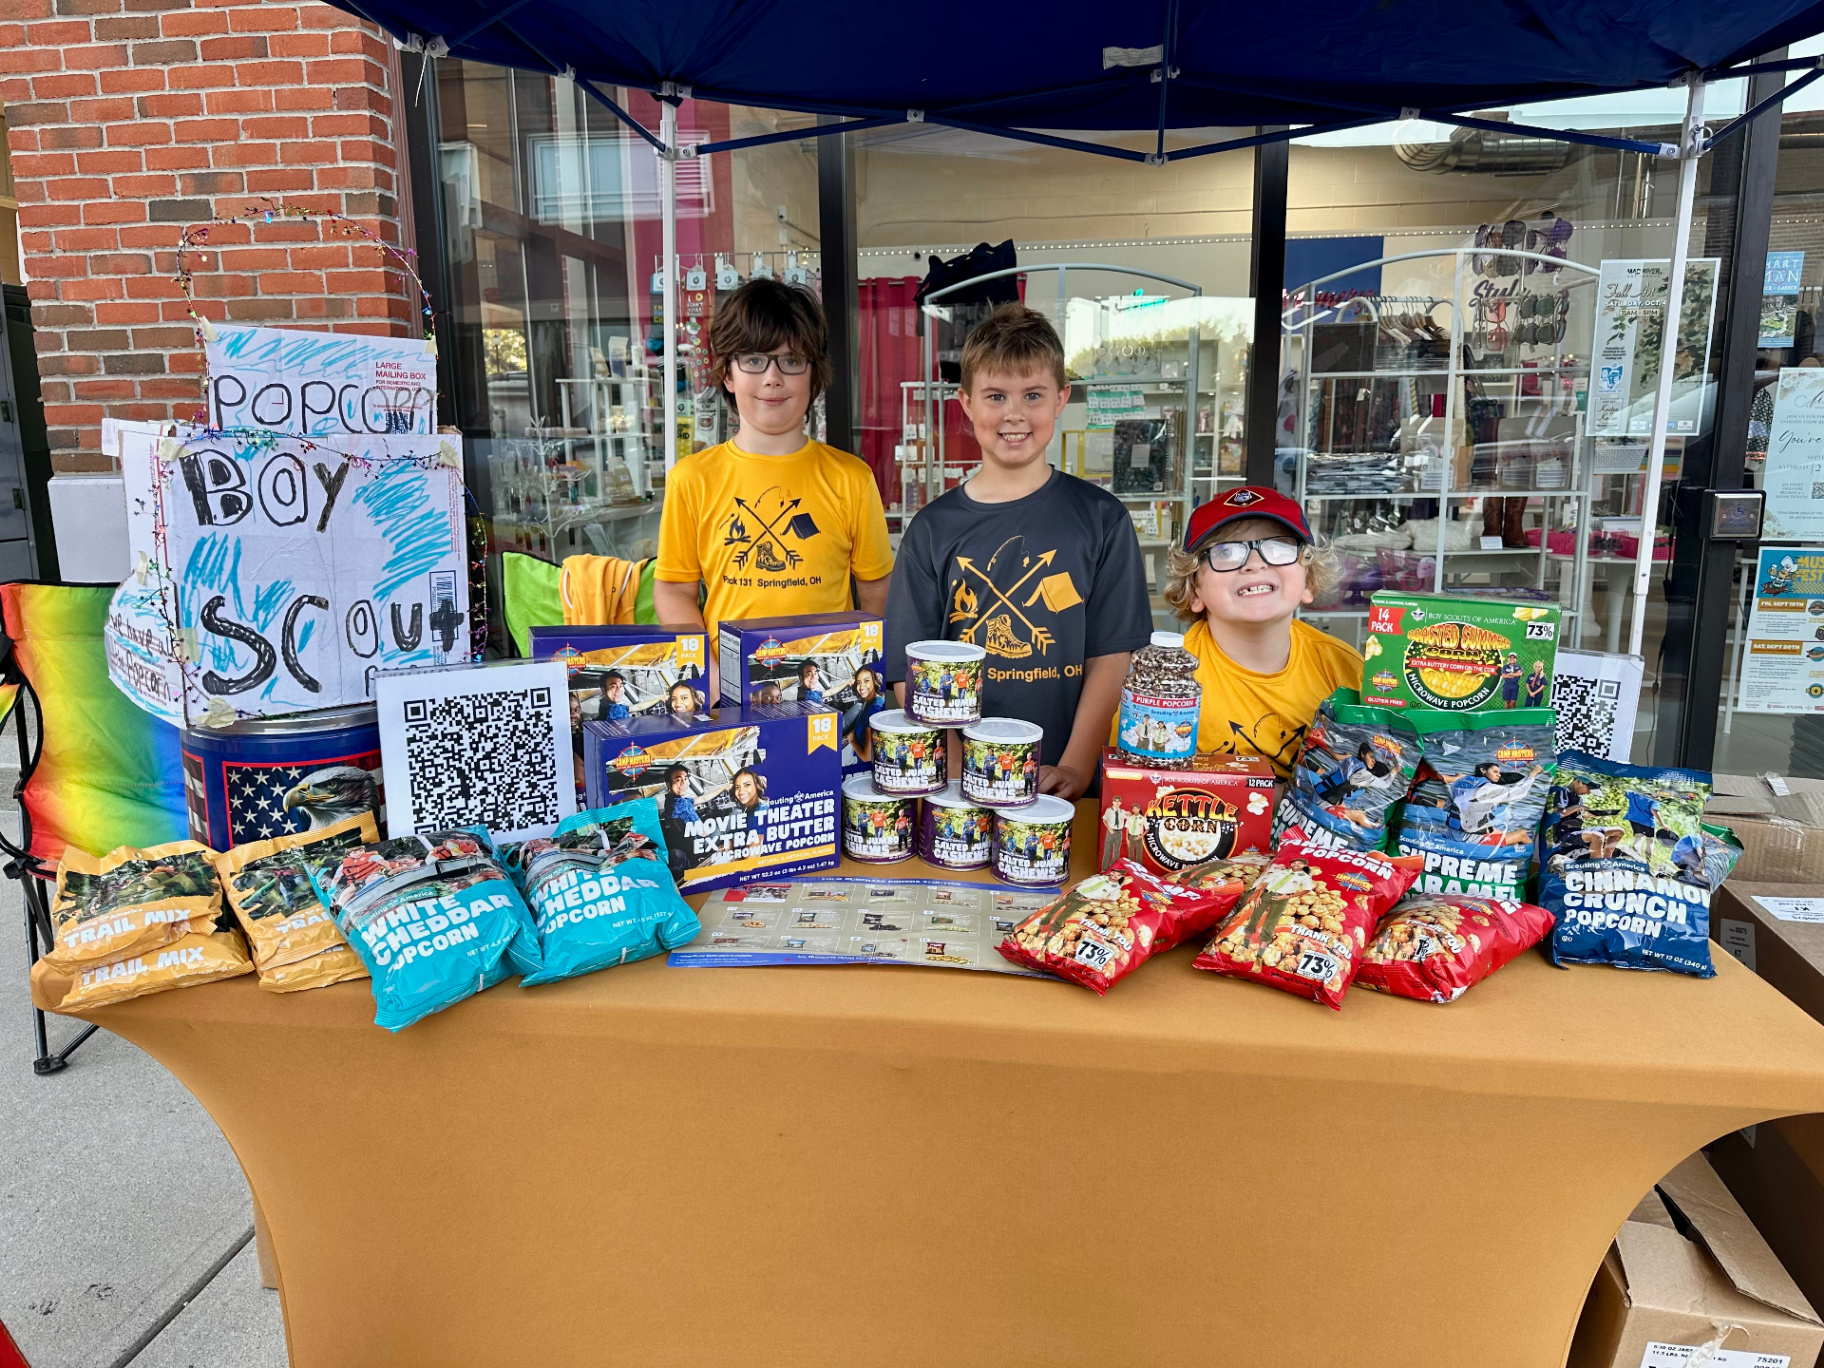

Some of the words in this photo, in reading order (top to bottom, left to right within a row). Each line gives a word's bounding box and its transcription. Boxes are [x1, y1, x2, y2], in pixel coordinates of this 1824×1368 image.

[375, 361, 402, 370] LARGE
[375, 370, 408, 380] MAILING
[409, 371, 427, 380] BOX
[179, 449, 349, 533] BOY
[739, 578, 752, 587] 131
[757, 578, 808, 589] Springfield,
[809, 576, 822, 585] OH
[1378, 608, 1390, 621] 14
[1427, 612, 1443, 620] BOY
[1444, 613, 1471, 622] SCOUTS
[1483, 617, 1516, 626] AMERICA
[863, 624, 879, 636] 18
[1371, 621, 1394, 633] PACK
[1528, 624, 1553, 638] 73%
[681, 638, 699, 651] 18
[1424, 646, 1481, 661] CORN
[1411, 659, 1427, 667] EXTRA
[1427, 661, 1449, 669] BUTTERY
[1449, 663, 1464, 671] CORN
[987, 666, 1061, 682] Springfield,
[1064, 664, 1083, 678] OH
[1408, 673, 1448, 708] MICROWAVE
[1451, 687, 1490, 709] POPCORN
[912, 694, 946, 707] SALTED
[1136, 696, 1160, 706] PURPLE
[1162, 700, 1195, 708] POPCORN
[1367, 696, 1389, 704] GLUTEN
[912, 703, 970, 718] CASHEWS
[812, 718, 832, 734] 18
[812, 734, 830, 742] PACK
[874, 763, 903, 778] SALTED
[904, 765, 937, 778] JUMBO
[874, 773, 929, 787] CASHEWS
[962, 771, 990, 788] SALTED
[992, 779, 1026, 789] JUMBO
[1248, 779, 1255, 787] 12
[1256, 779, 1274, 788] PACK
[804, 790, 834, 800] America
[962, 781, 1016, 799] CASHEWS
[1146, 794, 1239, 822] KETTLE
[684, 813, 747, 838] MOVIE
[754, 799, 835, 826] THEATER
[1163, 818, 1219, 834] CORN
[693, 830, 760, 855] EXTRA
[766, 816, 835, 842] BUTTER
[866, 836, 900, 845] JUMBO
[711, 841, 782, 863] MICROWAVE
[785, 832, 835, 850] POPCORN
[934, 839, 968, 851] SALTED
[1146, 832, 1180, 870] MICROWAVE
[933, 848, 991, 863] CASHEWS
[999, 852, 1031, 867] SALTED
[1033, 856, 1064, 868] JUMBO
[998, 861, 1056, 878] CASHEWS
[1300, 847, 1393, 881] POPCORN
[1565, 861, 1601, 870] Scouting
[400, 889, 434, 902] America
[1410, 874, 1521, 903] ARAMEL
[1563, 892, 1687, 924] CRUNCH
[63, 918, 136, 948] TRAIL
[144, 909, 191, 926] MIX
[361, 894, 462, 948] WHITE
[1564, 909, 1662, 938] POPCORN
[374, 894, 513, 966] CHEDDAR
[1079, 918, 1112, 939] THANK
[1113, 932, 1132, 951] YOU
[1290, 923, 1330, 943] THANK
[1333, 939, 1353, 960] YOU
[466, 949, 479, 957] NET
[479, 944, 490, 952] WT
[1078, 941, 1110, 965] 73%
[1654, 951, 1665, 959] WT
[82, 958, 148, 985] TRAIL
[157, 946, 205, 968] MIX
[1300, 953, 1335, 979] 73%
[1757, 1356, 1783, 1364] 75201
